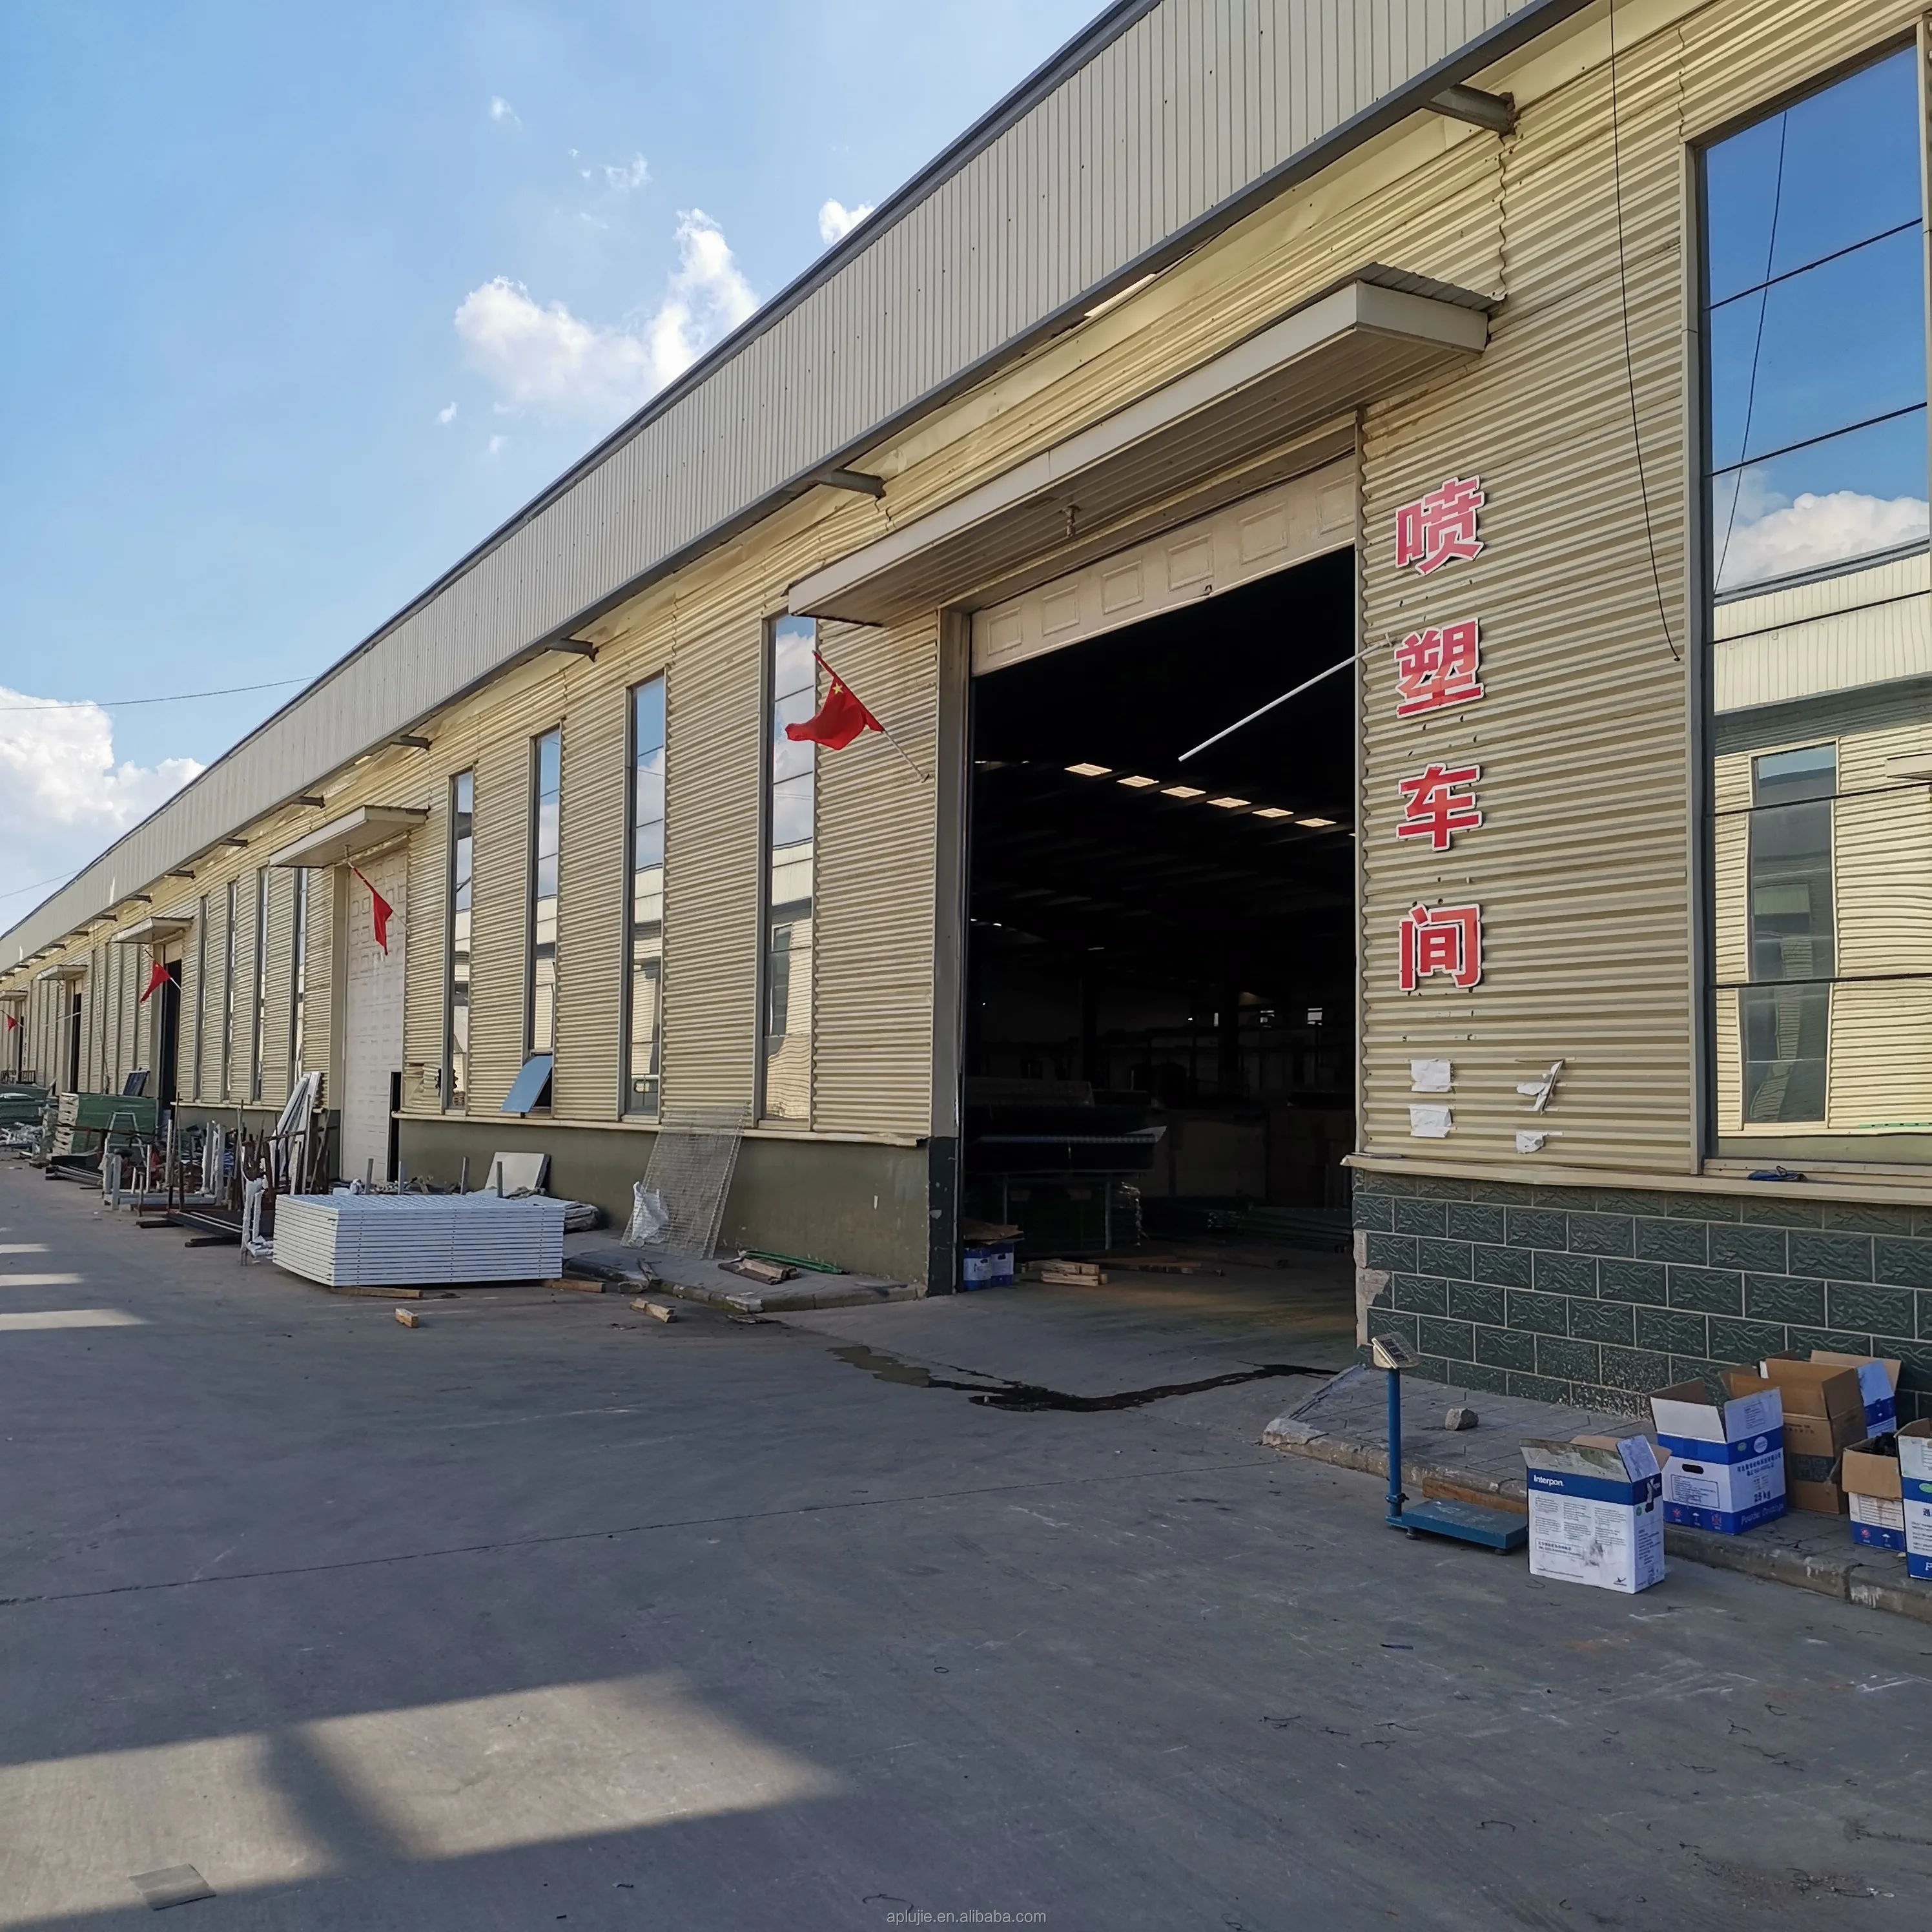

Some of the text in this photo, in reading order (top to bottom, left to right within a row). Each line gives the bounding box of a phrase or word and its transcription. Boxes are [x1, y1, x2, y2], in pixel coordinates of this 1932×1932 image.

[1395, 475, 1486, 992] 喷塑车间
[1534, 1474, 1563, 1486] Interpon
